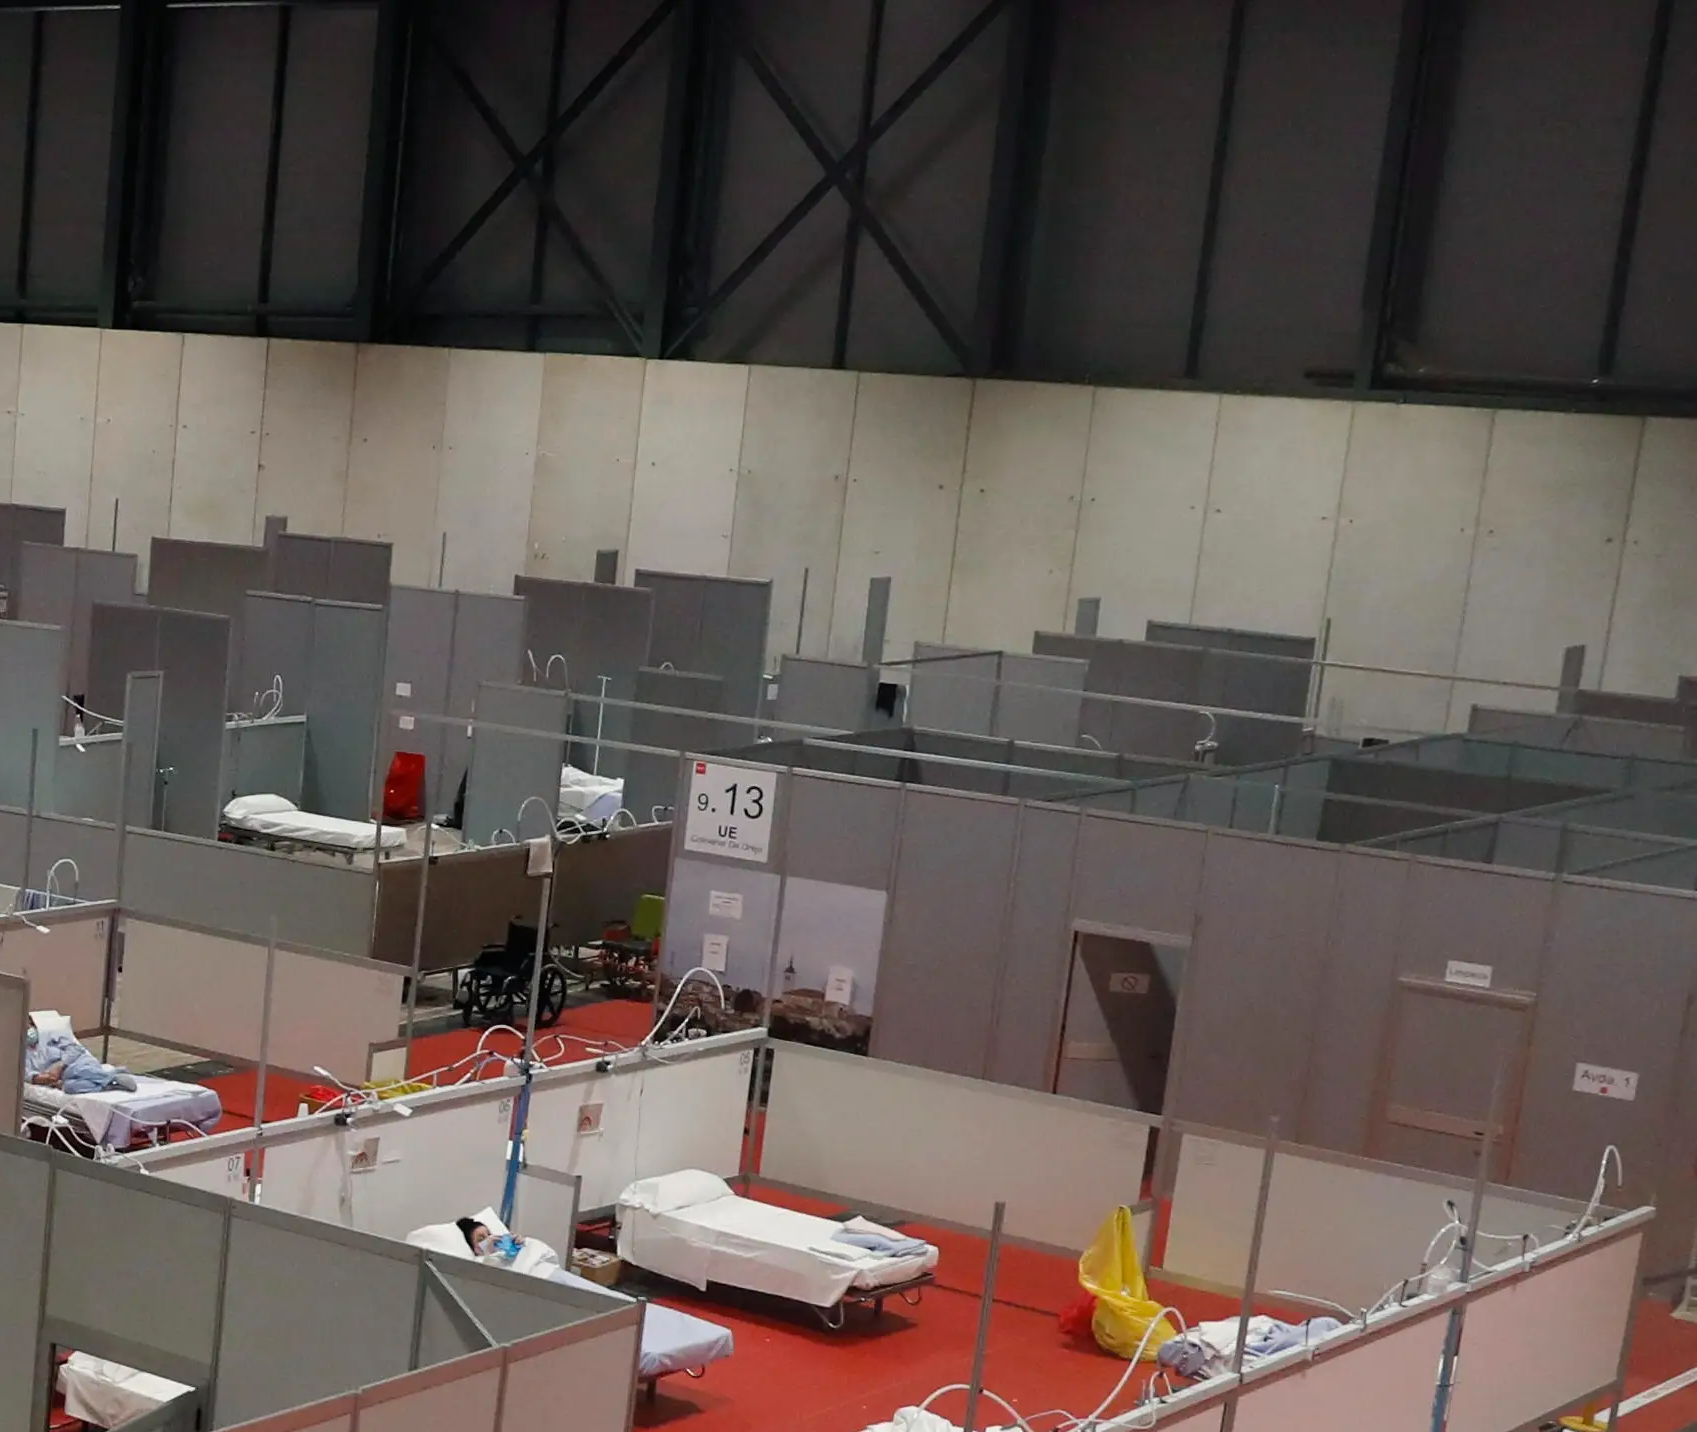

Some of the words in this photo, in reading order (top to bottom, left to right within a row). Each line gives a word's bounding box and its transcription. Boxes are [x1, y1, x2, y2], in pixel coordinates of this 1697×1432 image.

[697, 783, 764, 819] 9.13
[718, 825, 738, 839] UE
[227, 1156, 241, 1172] 07
